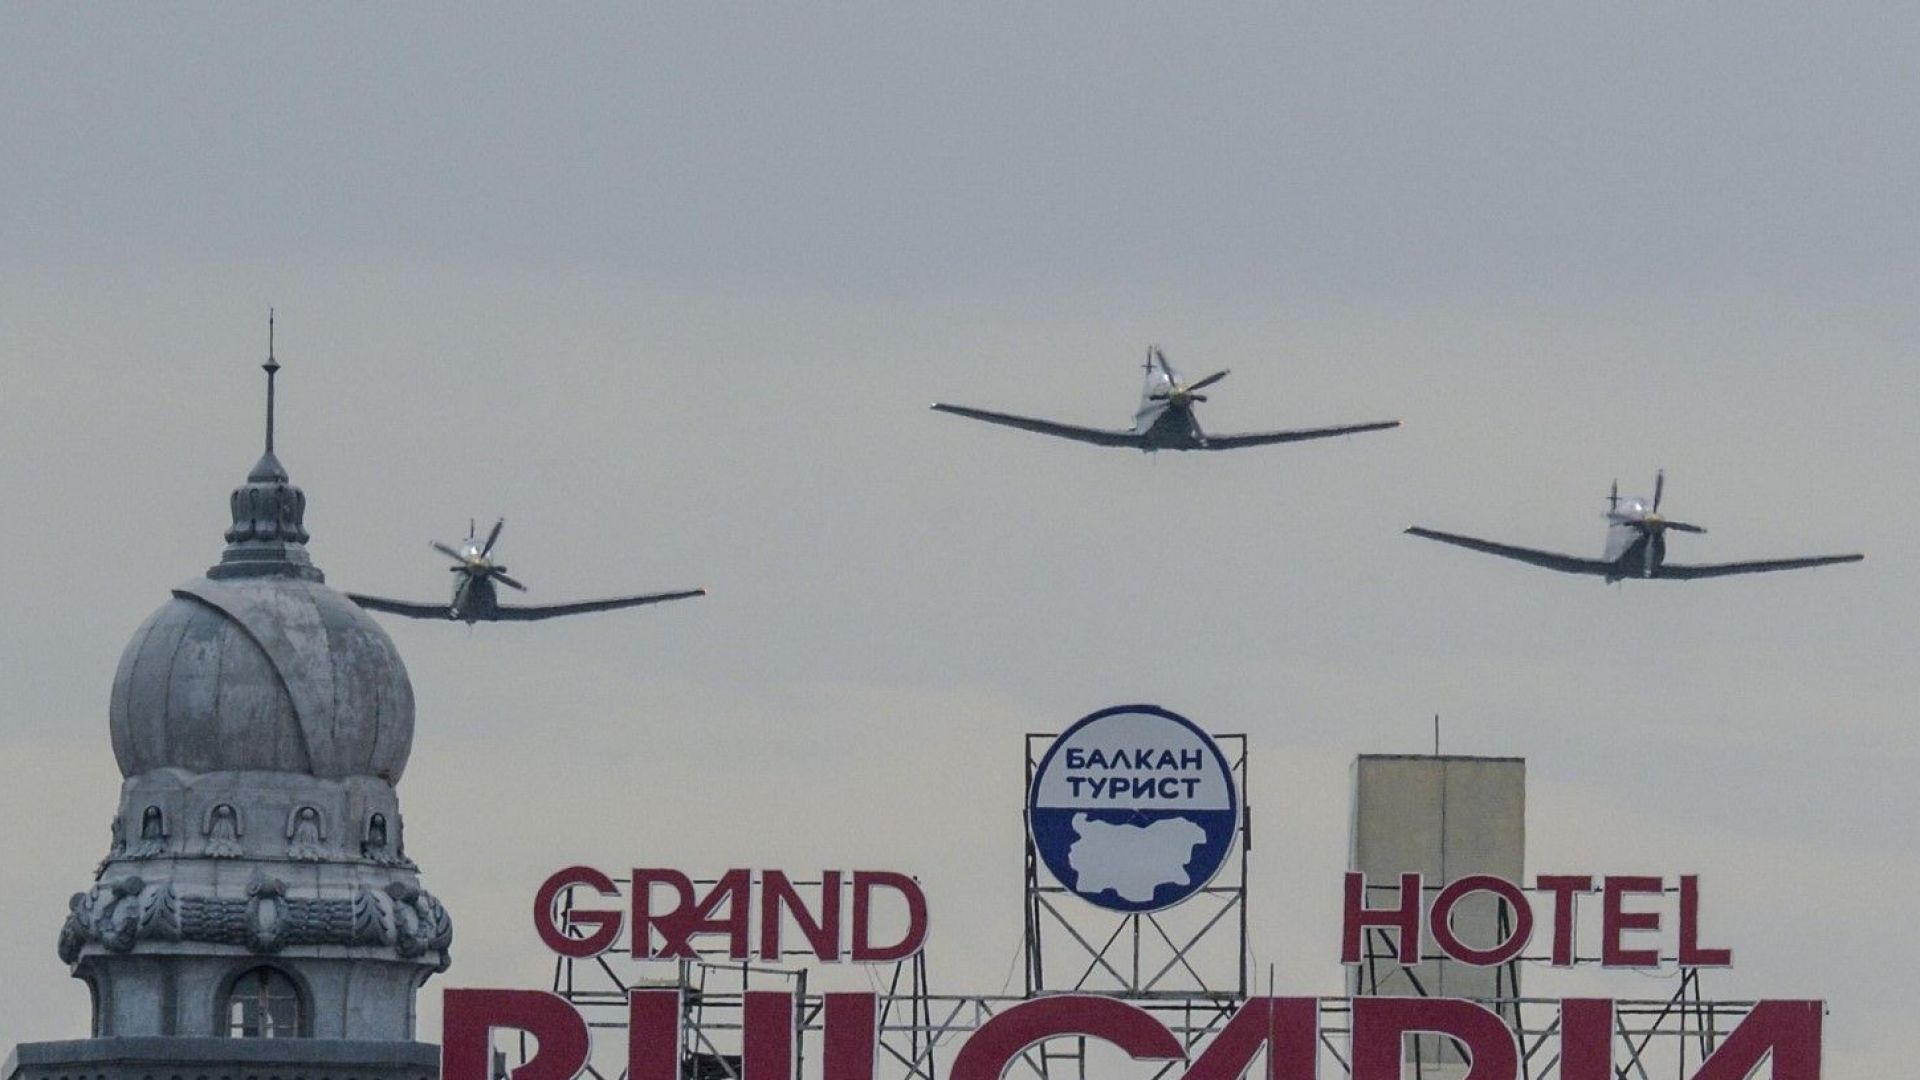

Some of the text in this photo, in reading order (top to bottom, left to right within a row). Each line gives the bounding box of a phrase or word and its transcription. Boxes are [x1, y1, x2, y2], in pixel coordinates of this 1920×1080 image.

[1066, 748, 1203, 770] БАЛКАН
[1066, 776, 1201, 799] ТУРИСТ
[533, 866, 1732, 968] GRAND HOTEL
